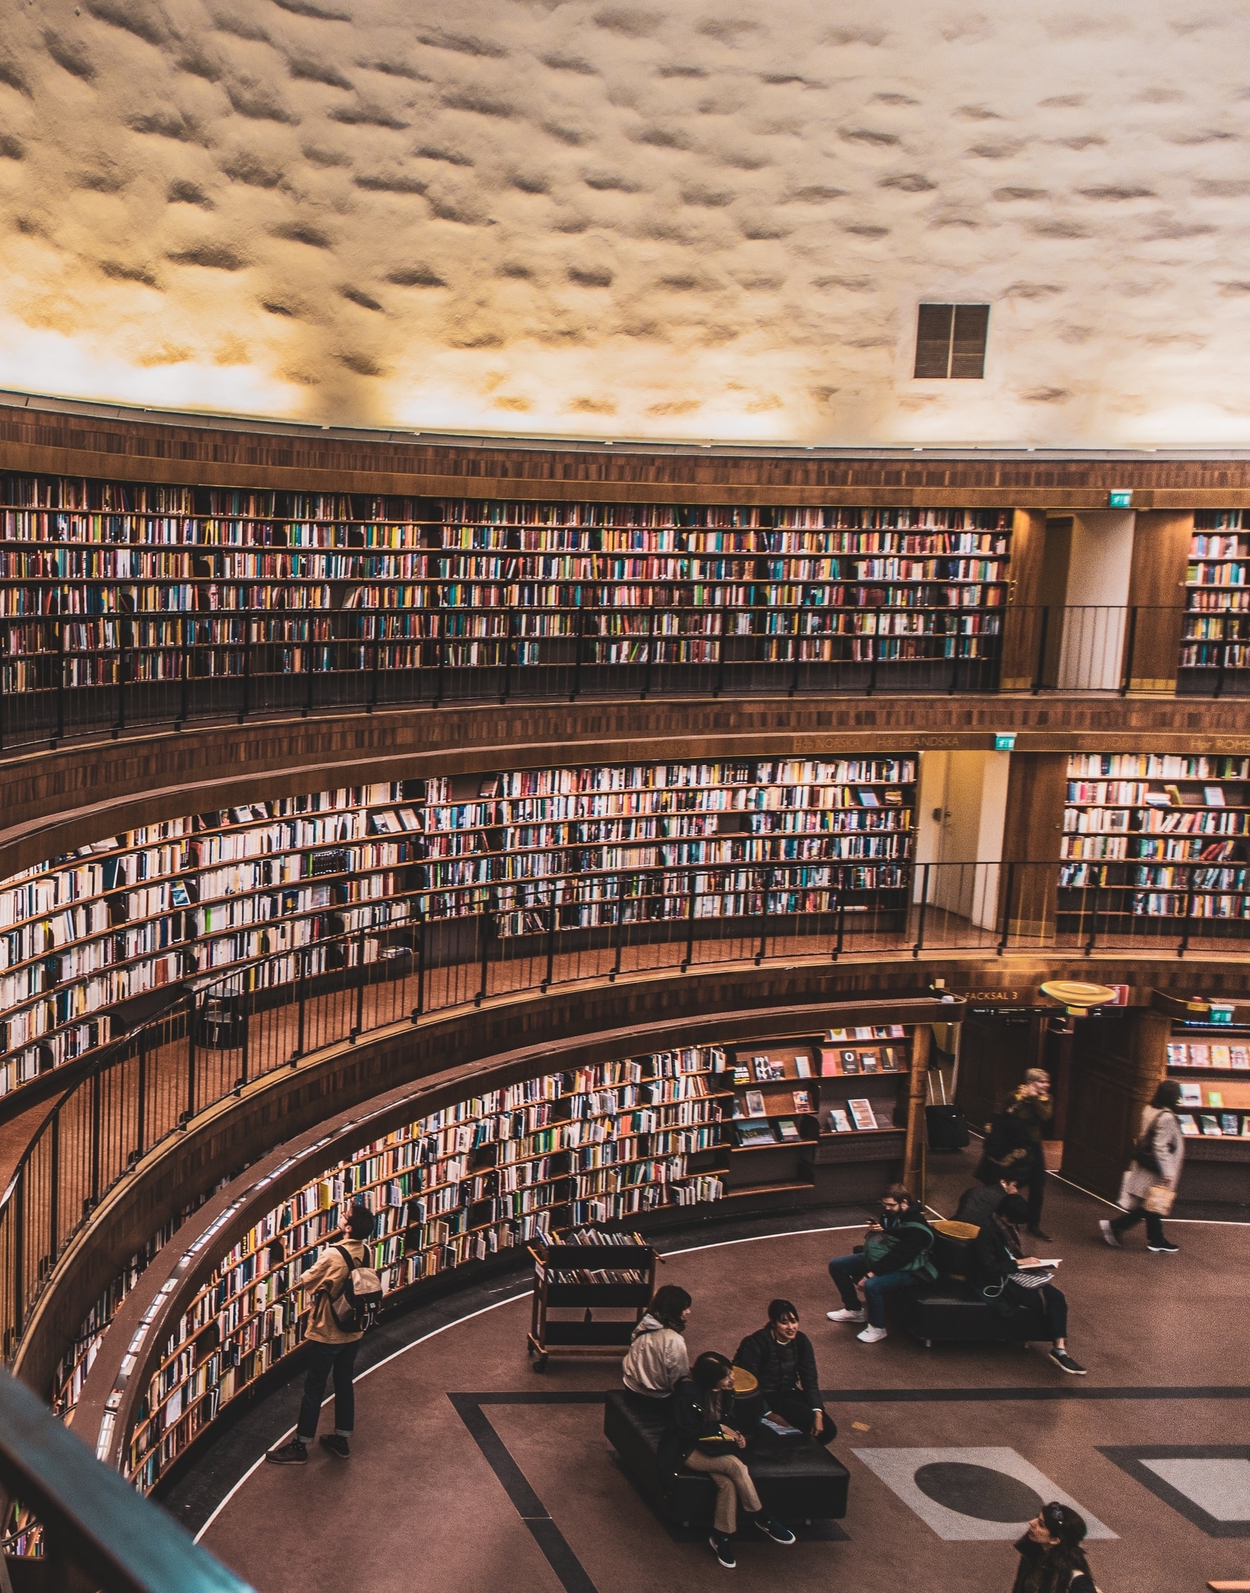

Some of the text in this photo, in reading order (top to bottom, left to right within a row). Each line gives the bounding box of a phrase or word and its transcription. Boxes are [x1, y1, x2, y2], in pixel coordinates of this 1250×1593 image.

[816, 738, 860, 748] NORSKA
[965, 991, 1018, 1000] FACKSAL 3
